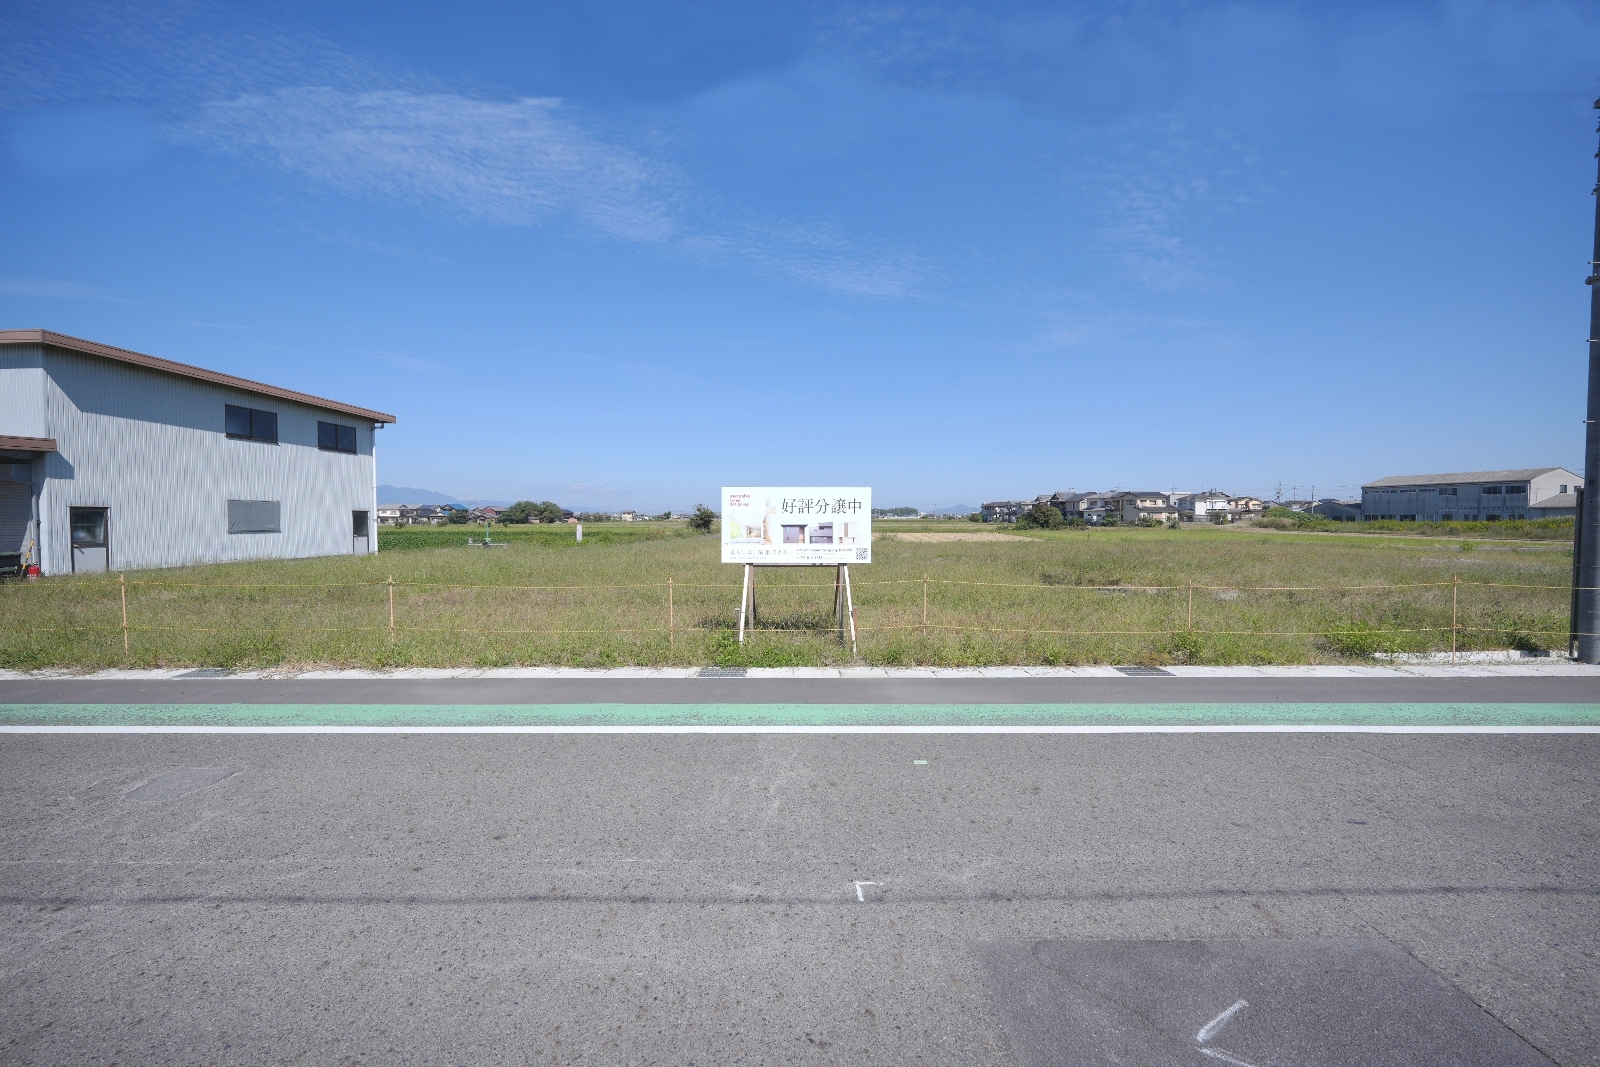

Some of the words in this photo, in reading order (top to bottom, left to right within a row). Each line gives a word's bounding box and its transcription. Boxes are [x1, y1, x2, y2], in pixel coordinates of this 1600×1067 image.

[781, 497, 862, 515] 好評分譲中
